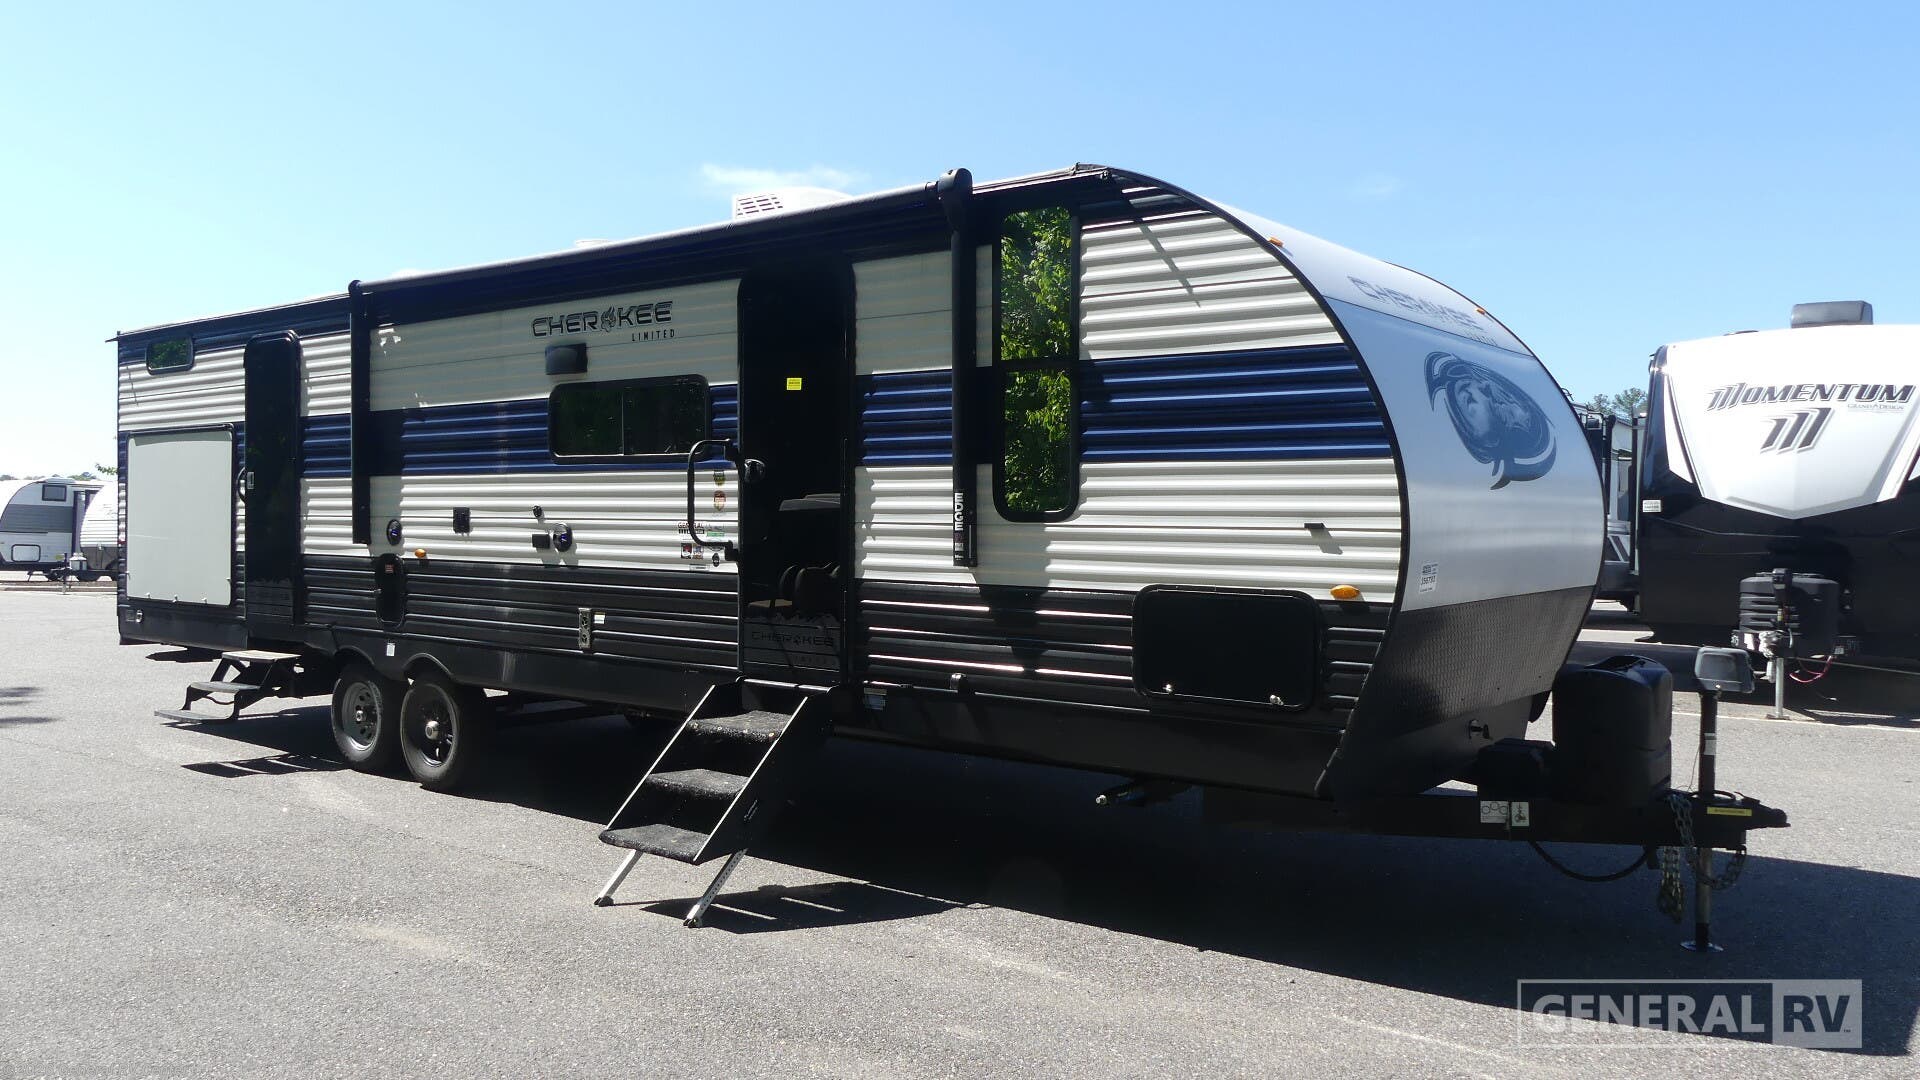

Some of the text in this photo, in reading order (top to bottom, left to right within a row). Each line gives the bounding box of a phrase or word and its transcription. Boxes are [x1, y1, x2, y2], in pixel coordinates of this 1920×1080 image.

[532, 301, 673, 337] CHEROKEE
[632, 329, 675, 342] LIMITED
[1706, 382, 1916, 411] MOMENTUM
[954, 492, 964, 531] EDGE
